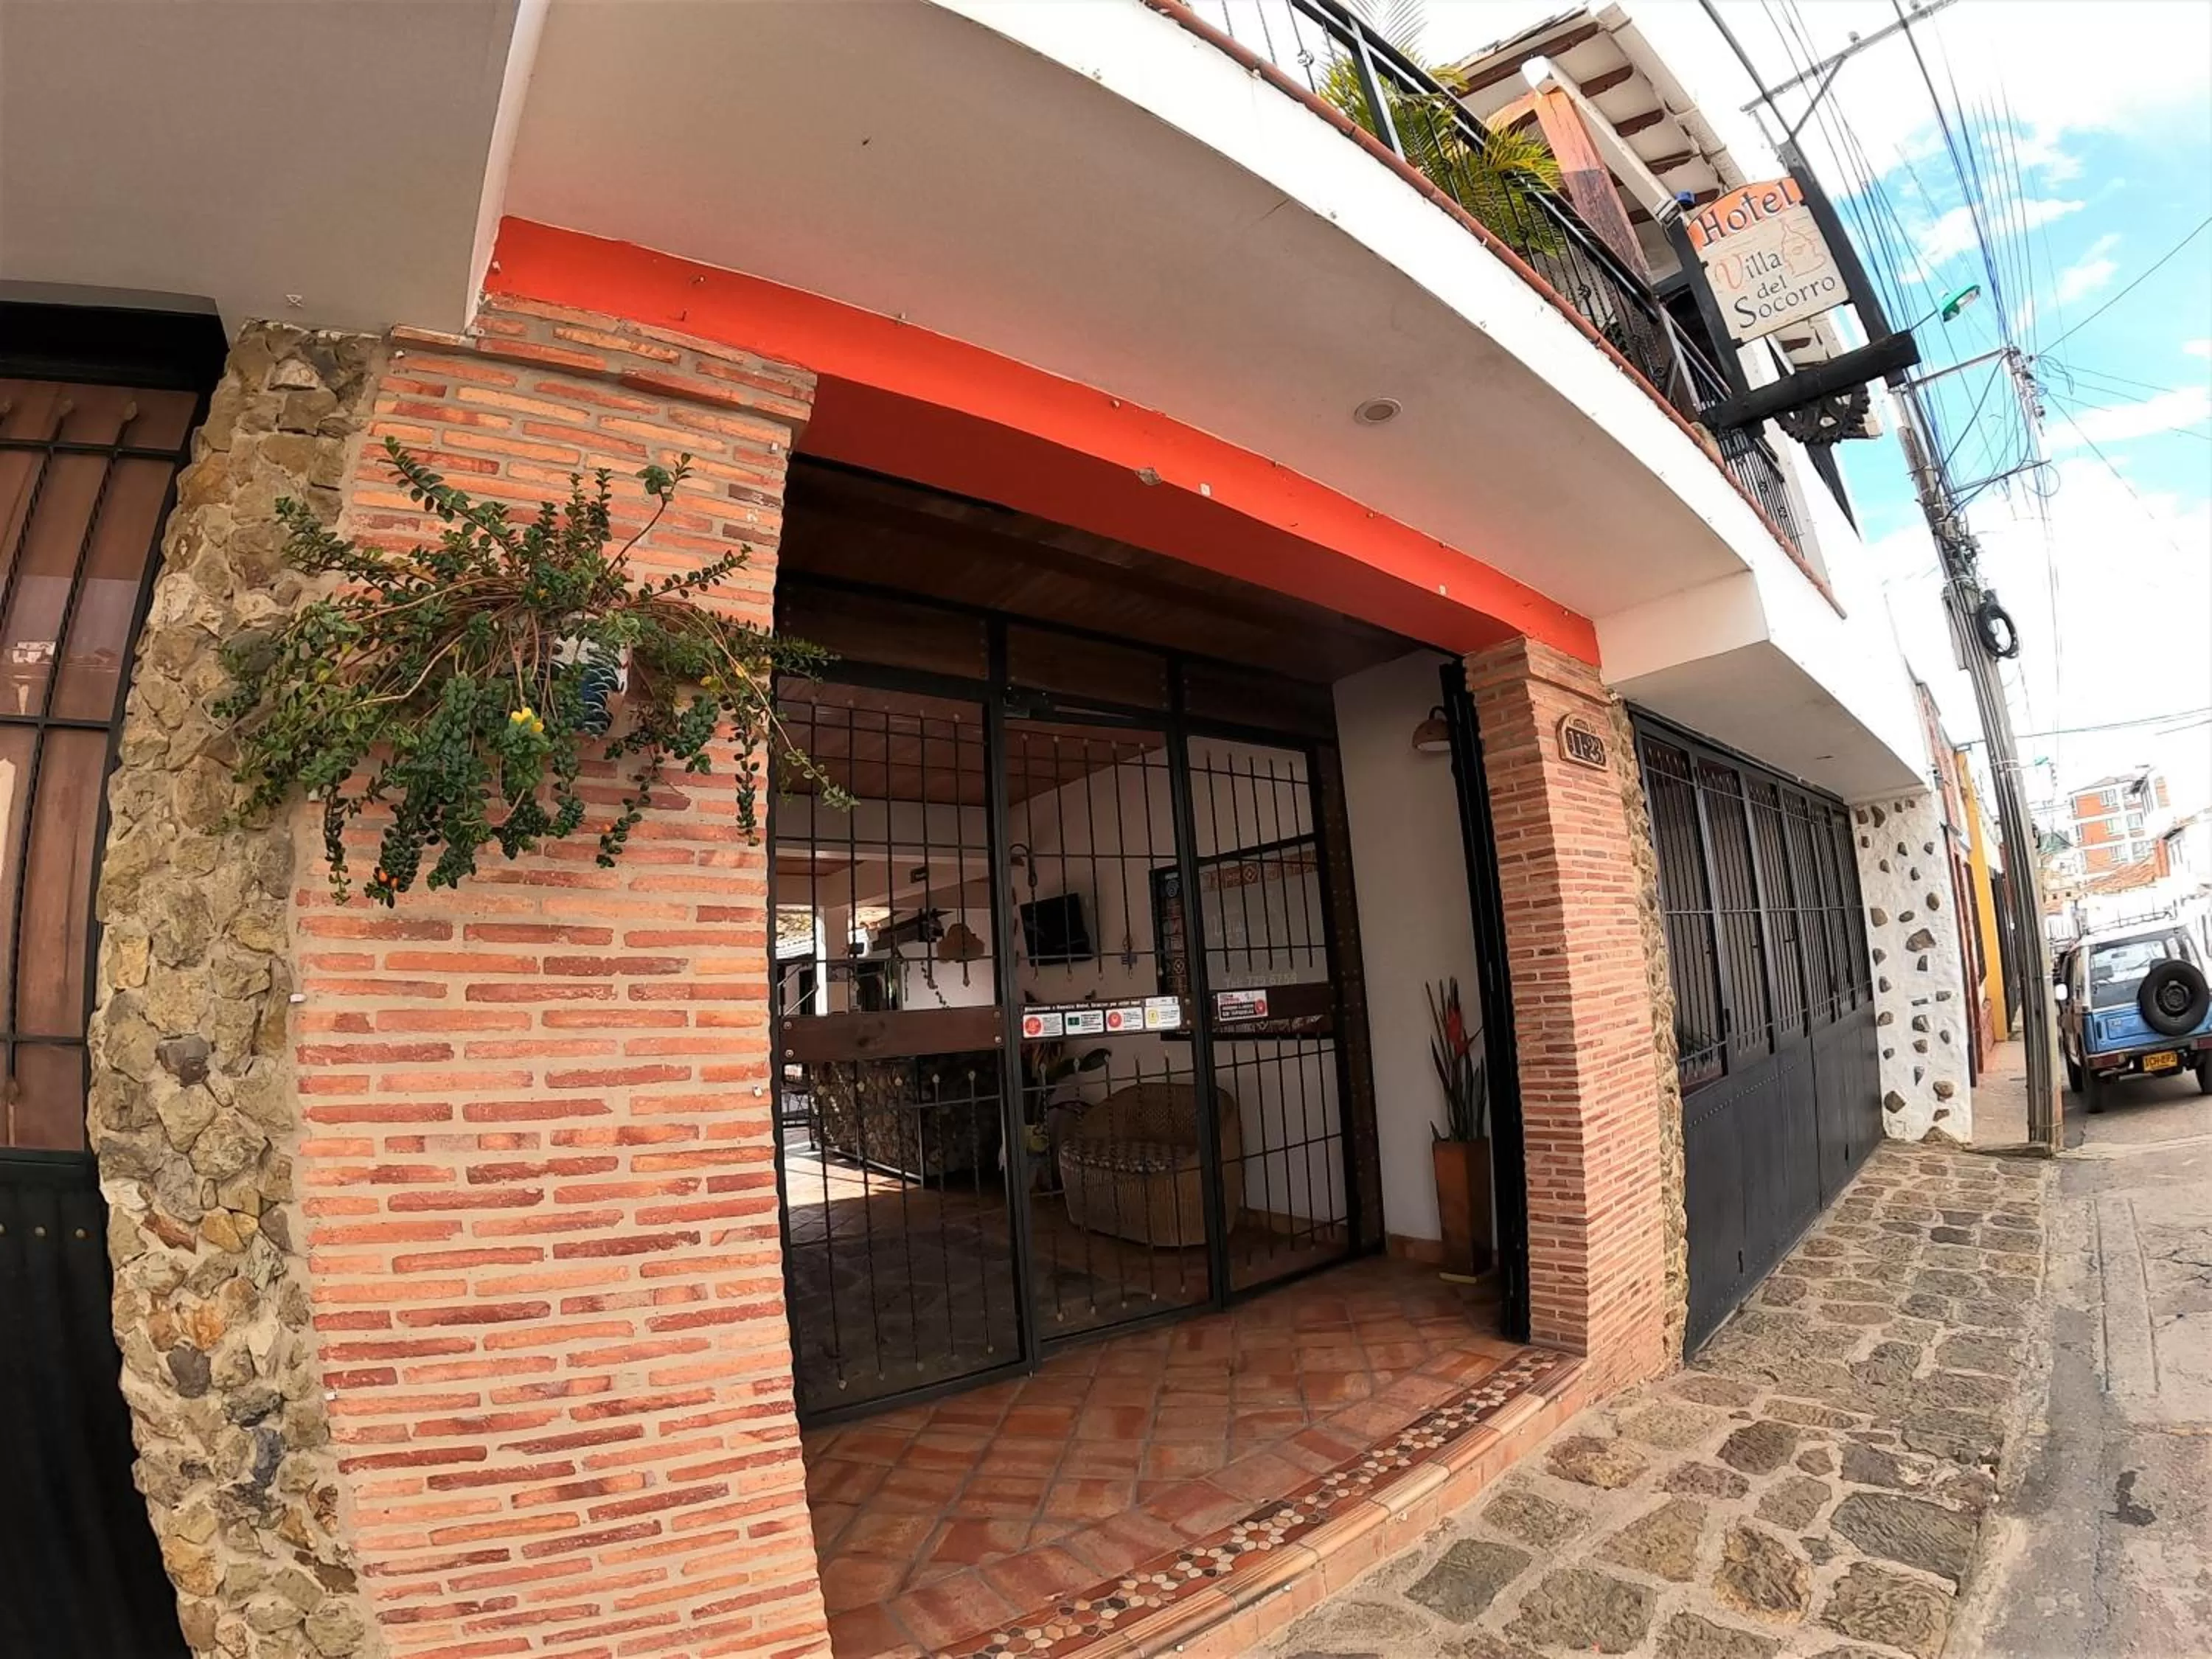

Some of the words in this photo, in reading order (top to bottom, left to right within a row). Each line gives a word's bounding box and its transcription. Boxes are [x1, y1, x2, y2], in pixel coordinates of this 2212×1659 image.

[1699, 181, 1795, 247] Hotel
[1714, 251, 1782, 290] Villa
[1757, 275, 1787, 299] del
[1734, 276, 1835, 329] Socorro
